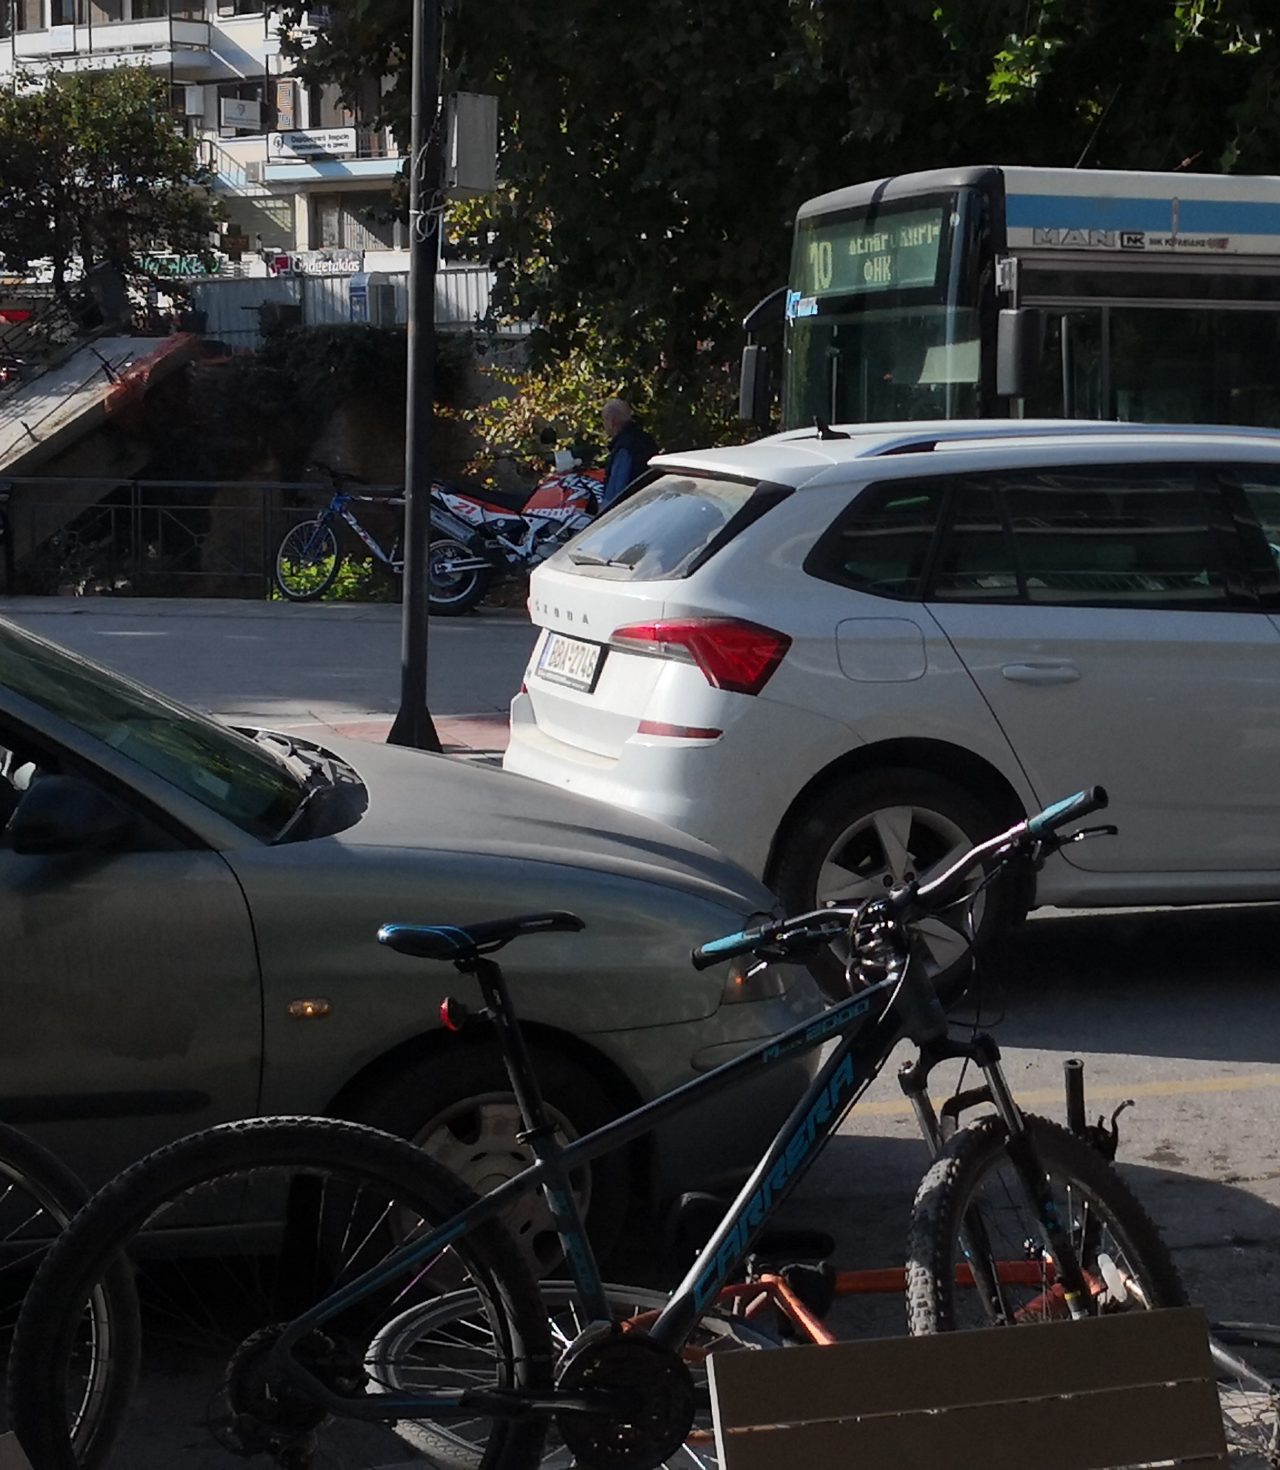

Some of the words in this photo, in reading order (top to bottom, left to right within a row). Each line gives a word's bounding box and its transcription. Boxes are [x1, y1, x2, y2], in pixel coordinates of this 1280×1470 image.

[1033, 228, 1116, 248] MAN
[809, 240, 833, 291] 10
[694, 1051, 857, 1312] CARRERA
